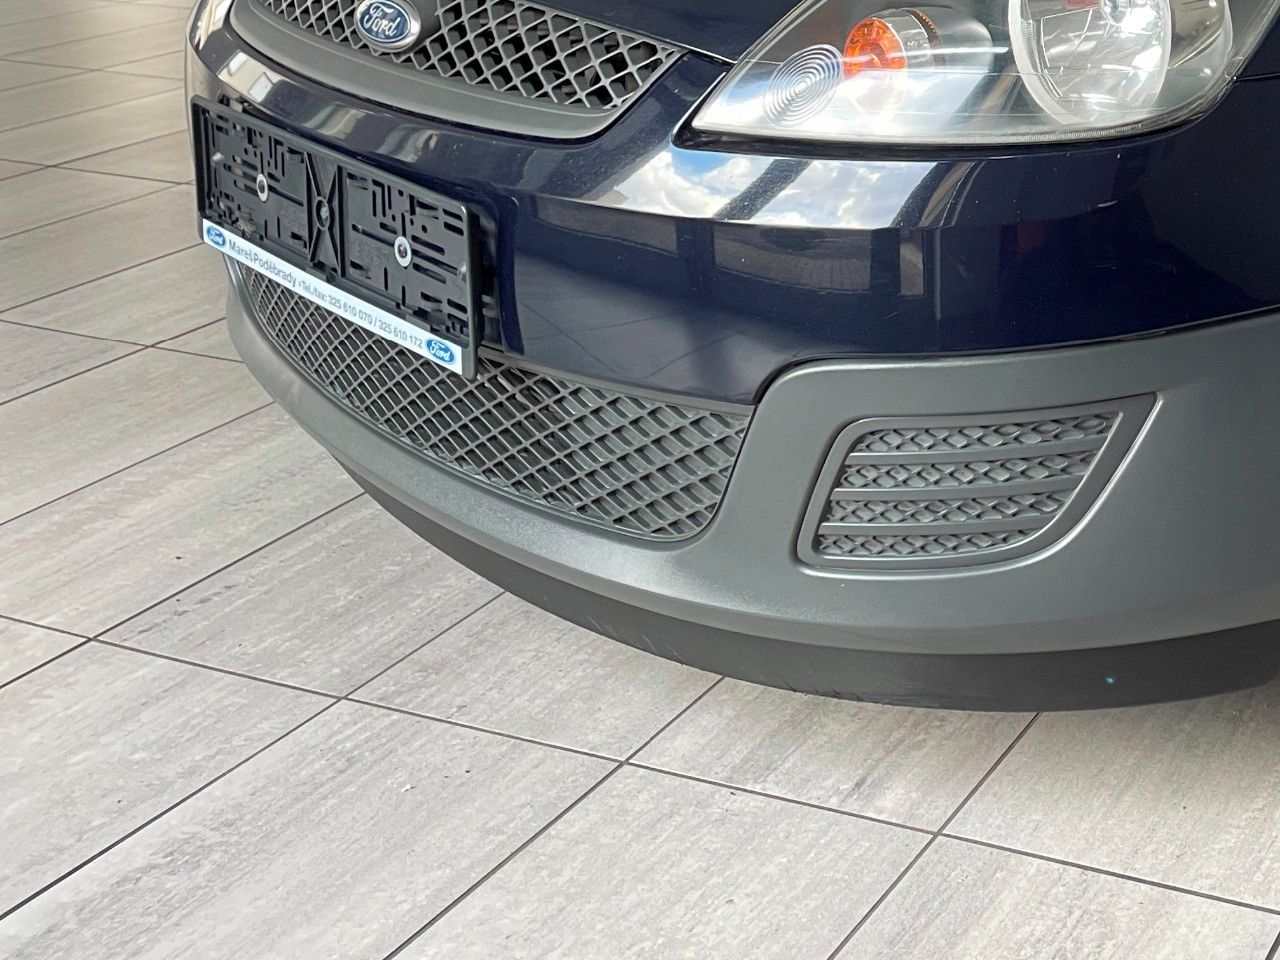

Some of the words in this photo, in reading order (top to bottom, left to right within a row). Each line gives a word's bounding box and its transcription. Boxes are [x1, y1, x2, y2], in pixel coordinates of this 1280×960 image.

[363, 2, 402, 37] Ford
[254, 251, 297, 288] Poděbrady
[328, 294, 343, 309] 325
[343, 301, 357, 317] 610
[358, 309, 373, 324] 070
[378, 318, 393, 335] 325
[393, 325, 408, 341] 610
[409, 333, 423, 349] 172
[428, 340, 453, 363] Ford
